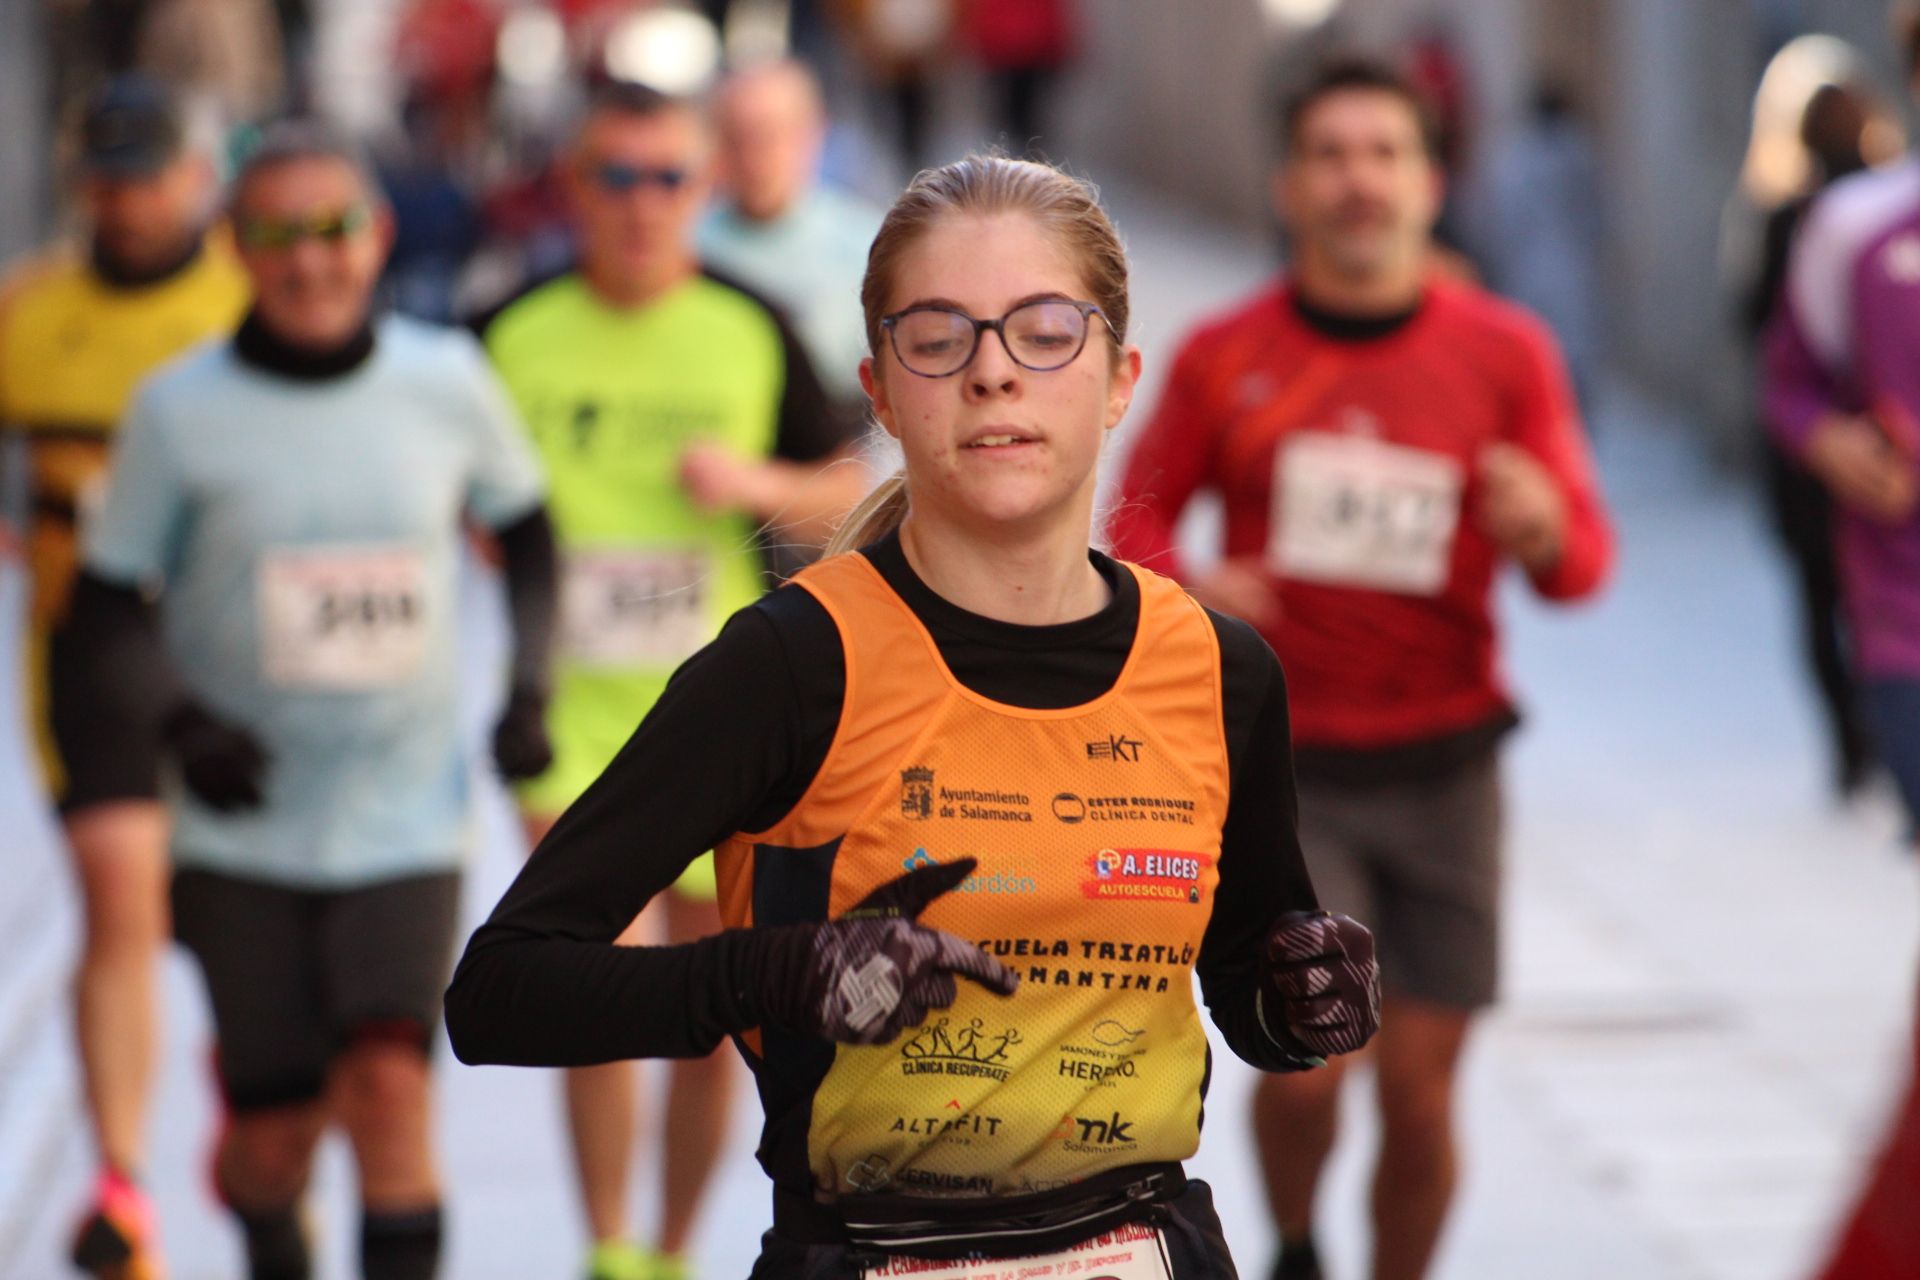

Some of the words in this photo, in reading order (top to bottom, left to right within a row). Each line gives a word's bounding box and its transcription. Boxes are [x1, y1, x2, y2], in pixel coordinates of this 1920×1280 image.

[1086, 734, 1143, 762] EKT
[939, 785, 1030, 806] Ayuntamiento
[1087, 797, 1129, 808] ESTER
[940, 804, 956, 818] de
[960, 804, 1033, 822] Salamanca
[1151, 811, 1195, 826] DENTAL
[1121, 853, 1143, 877] A.
[1145, 855, 1199, 880] ELICES
[1098, 883, 1185, 899] AUTOESCUELA
[1062, 1139, 1138, 1154] Salamanca
